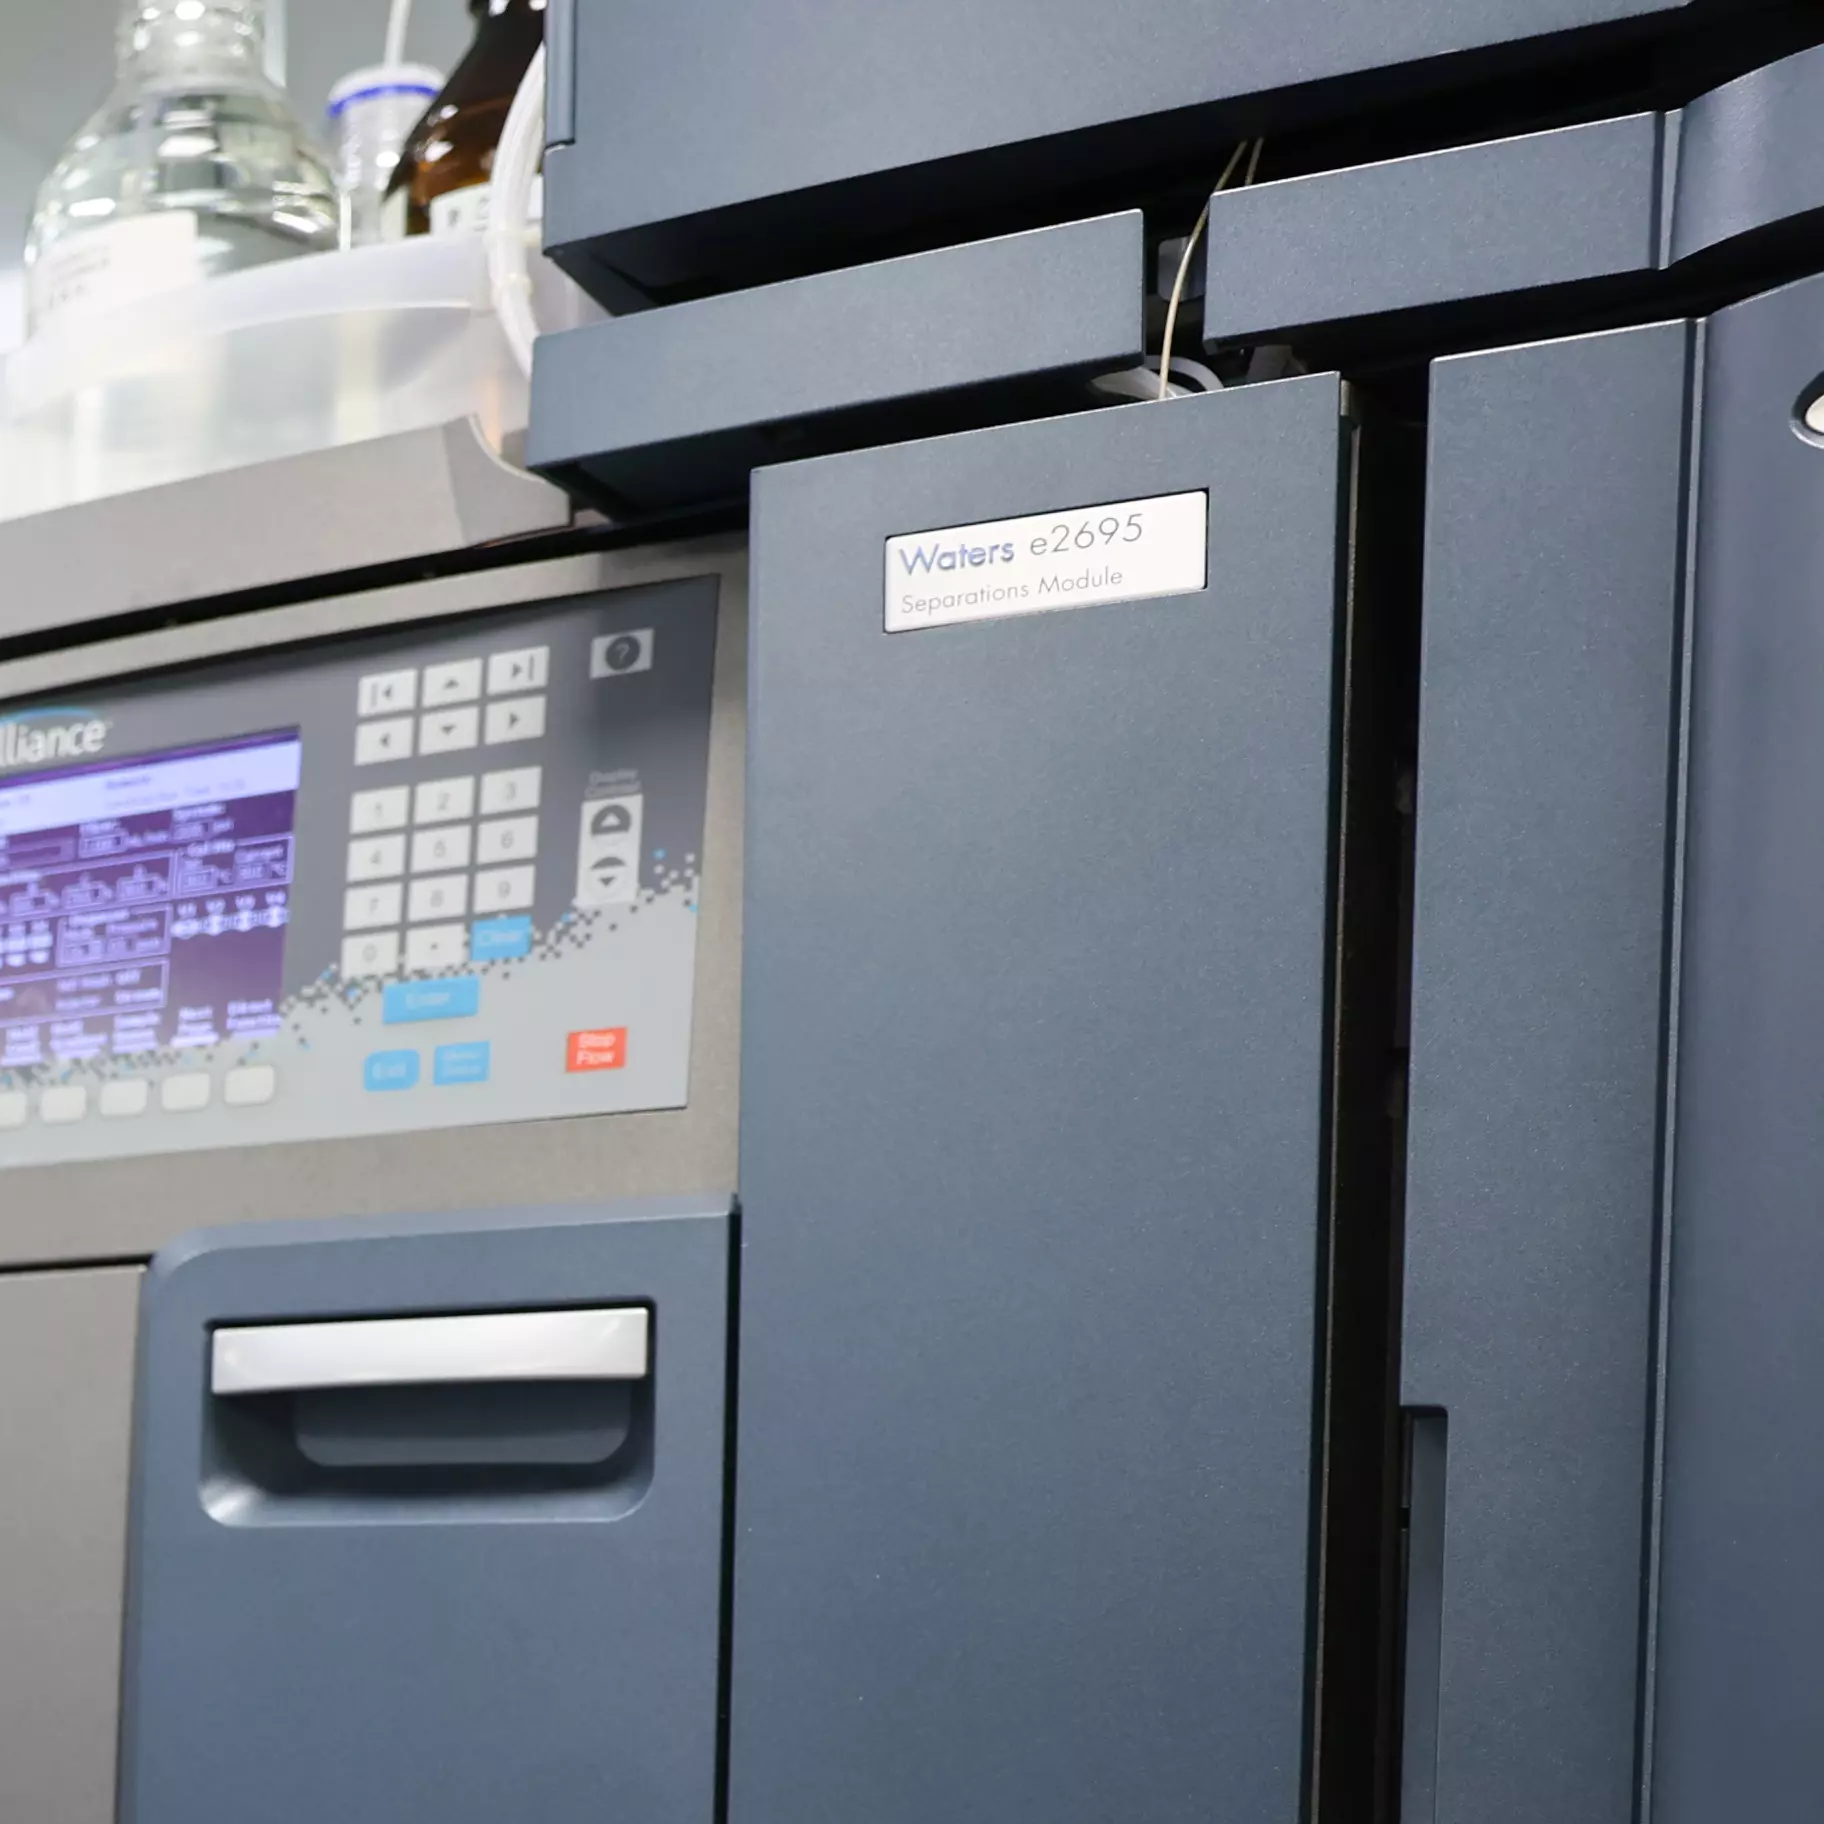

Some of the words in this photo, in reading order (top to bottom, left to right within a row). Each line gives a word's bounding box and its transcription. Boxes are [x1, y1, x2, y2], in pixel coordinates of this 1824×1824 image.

[899, 542, 1015, 576] Waters
[1029, 512, 1144, 556] e2695
[901, 584, 1030, 616] Separations
[1038, 565, 1124, 595] Module
